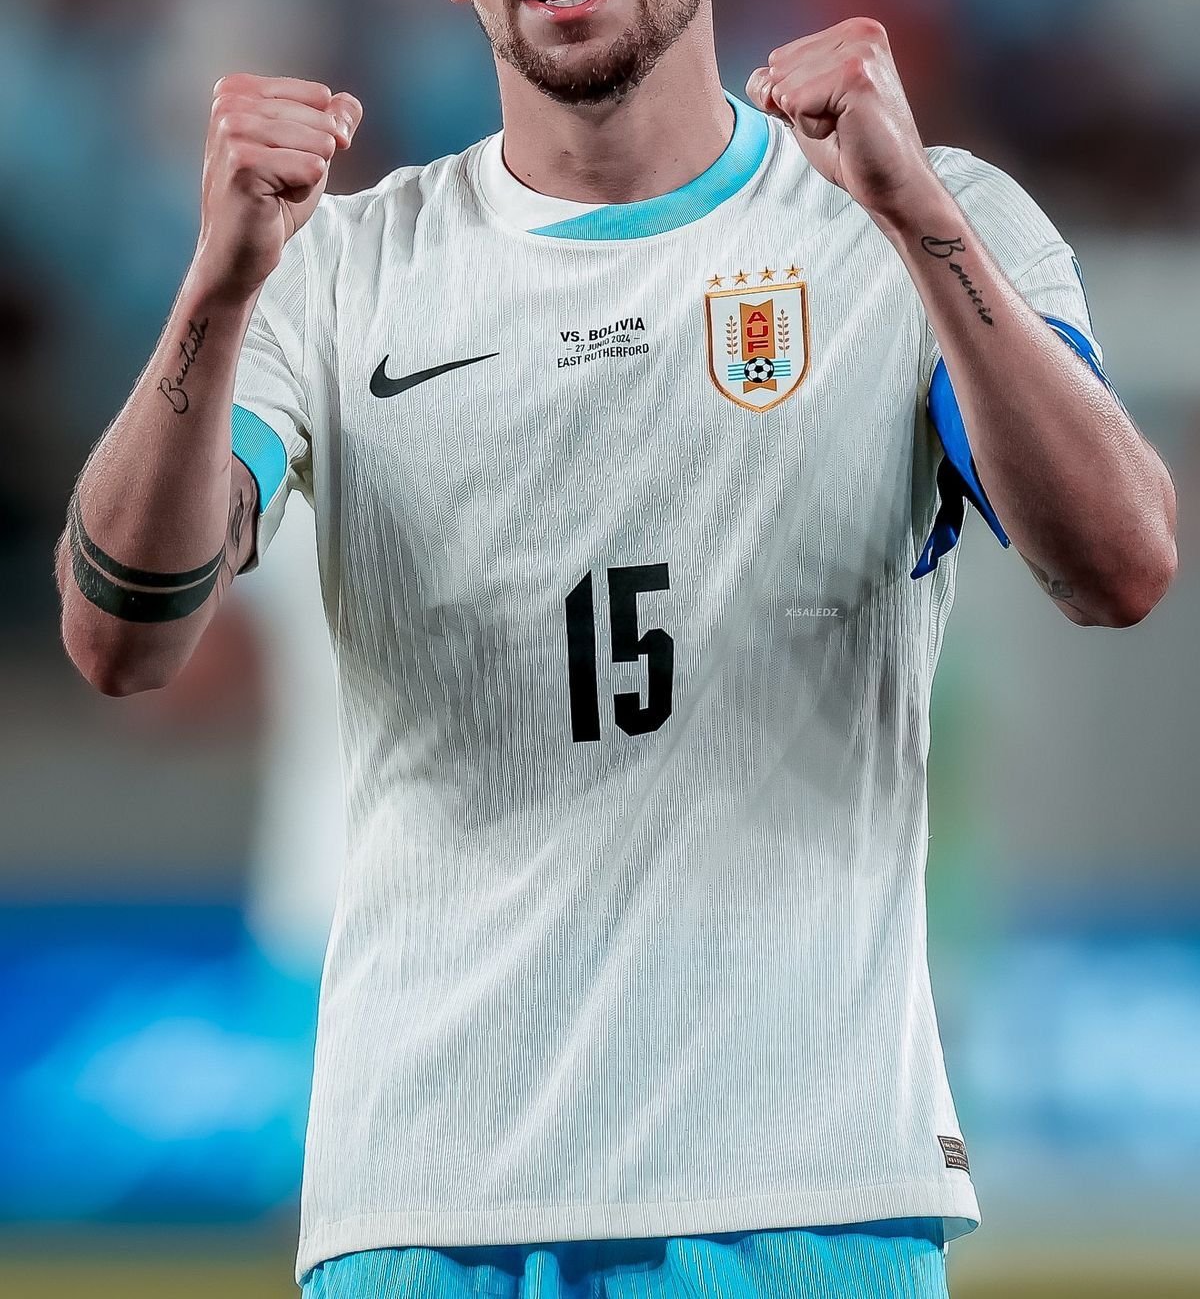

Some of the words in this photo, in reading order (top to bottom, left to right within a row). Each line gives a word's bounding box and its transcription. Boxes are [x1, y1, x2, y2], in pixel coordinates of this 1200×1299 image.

[560, 330, 585, 343] VS.
[588, 317, 646, 341] BOLIVIA
[746, 311, 769, 354] AUF
[557, 355, 582, 368] EAST
[584, 343, 650, 363] RUTHERFORD
[575, 344, 586, 353] 27
[587, 337, 610, 352] JUNIO
[611, 334, 631, 343] 2024
[565, 563, 674, 743] 15
